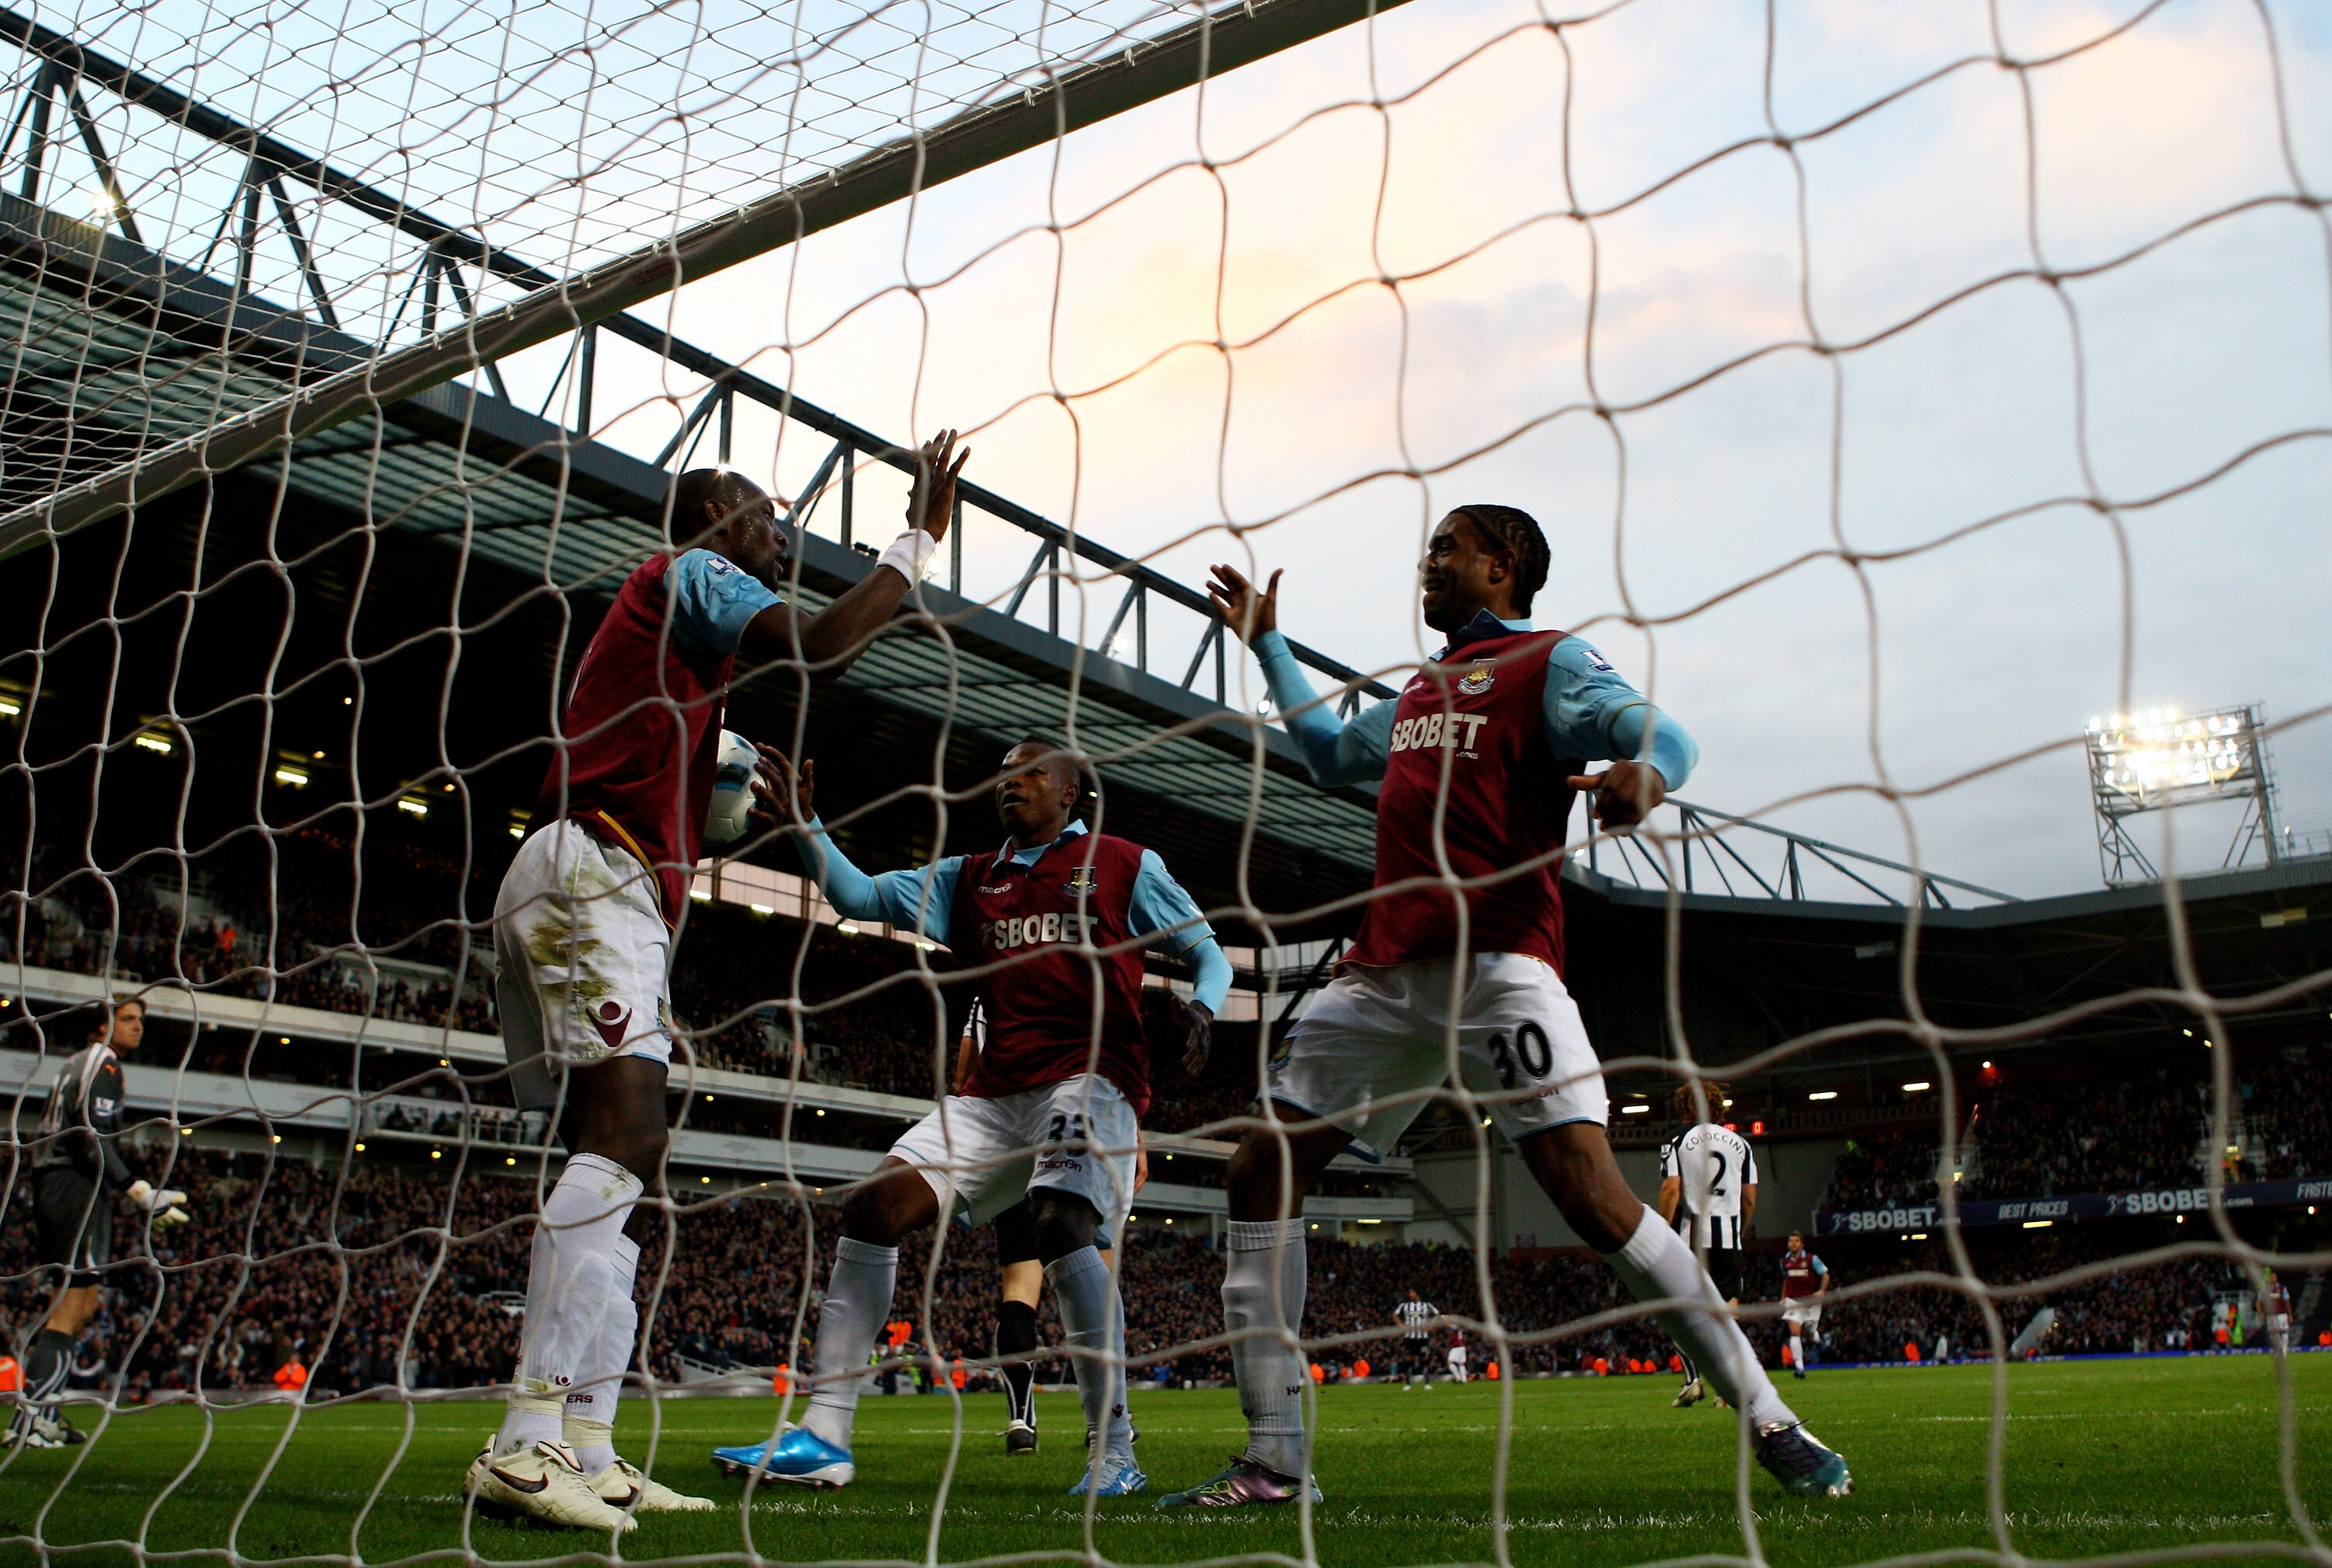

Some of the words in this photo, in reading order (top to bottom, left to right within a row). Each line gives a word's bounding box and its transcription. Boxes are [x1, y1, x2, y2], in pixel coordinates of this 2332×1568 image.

[1390, 712, 1488, 753] SBOBET
[979, 882, 1012, 894] macro
[994, 913, 1098, 950] SBOBET
[1488, 1021, 1552, 1090] 30
[1037, 1158, 1082, 1172] macron
[1706, 1150, 1726, 1196] 2
[1999, 1203, 2027, 1220] BEST
[2029, 1200, 2068, 1217] PRICES
